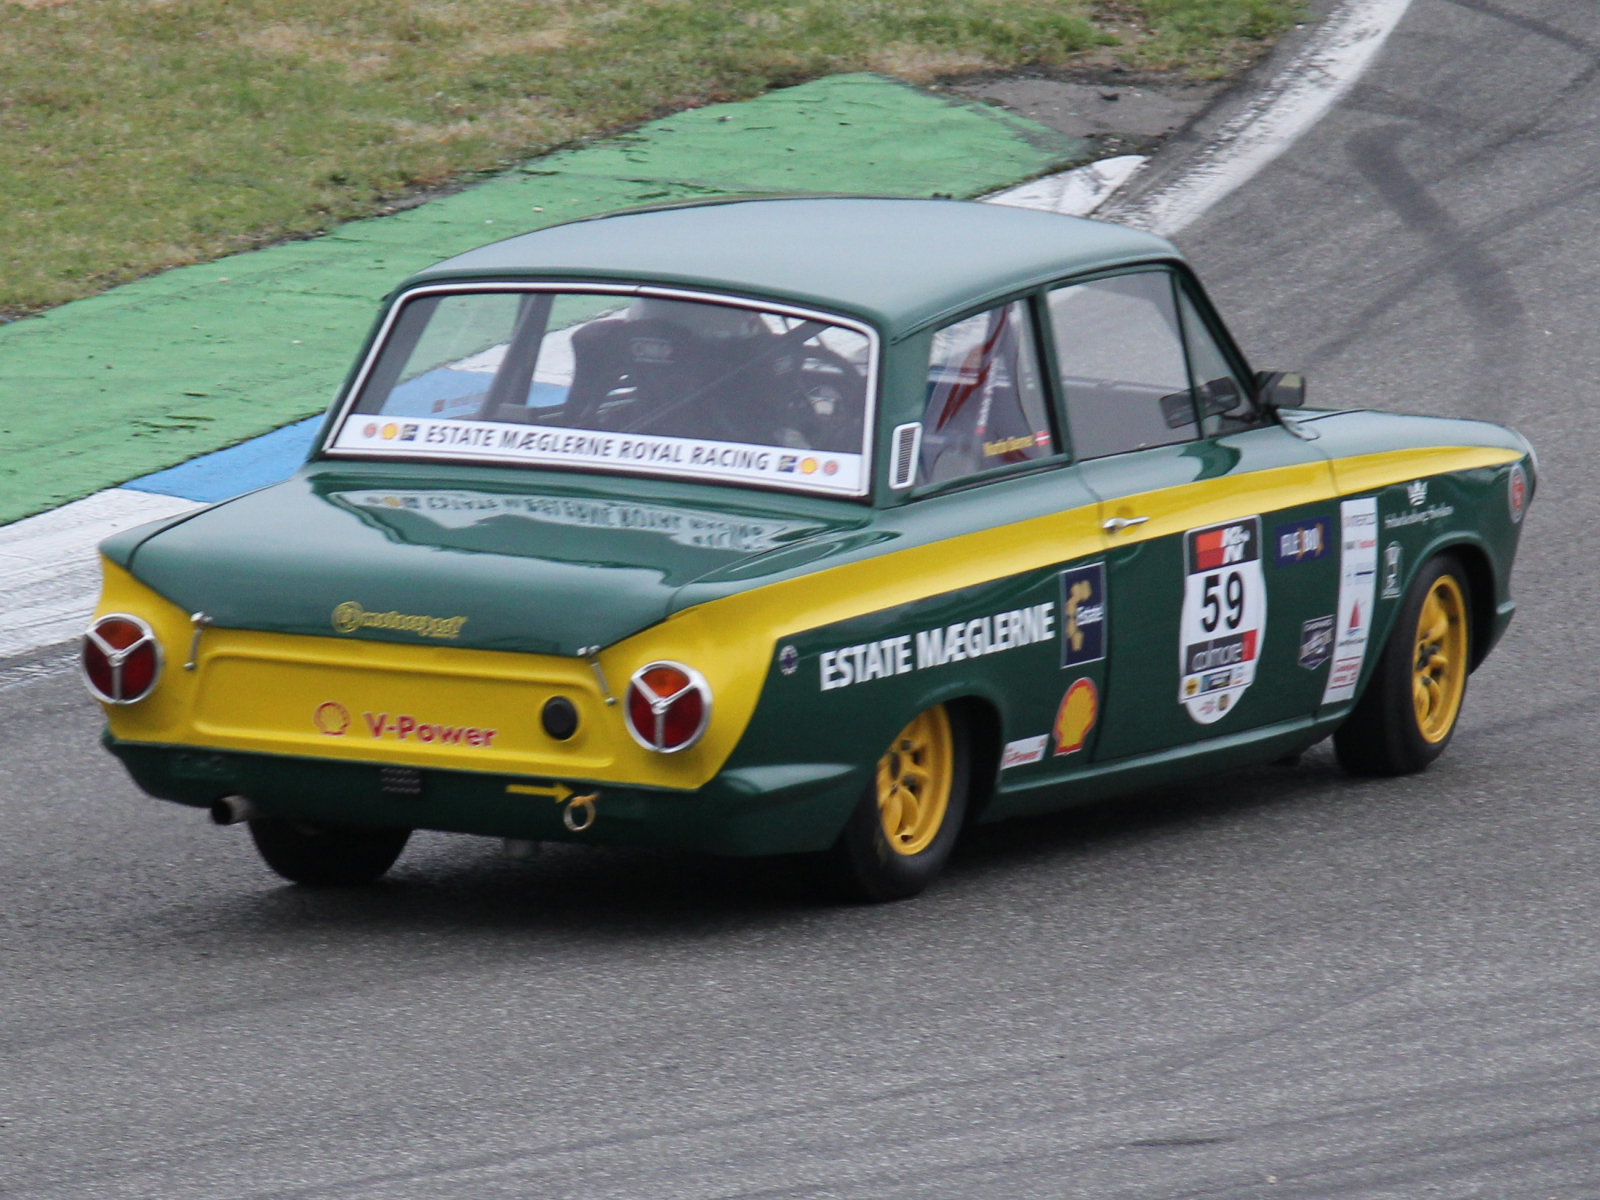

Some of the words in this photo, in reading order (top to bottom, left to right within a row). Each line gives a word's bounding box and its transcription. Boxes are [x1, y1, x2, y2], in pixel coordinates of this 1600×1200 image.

[424, 424, 494, 447] ESTATE
[499, 430, 616, 457] MÆGLERNE
[618, 440, 683, 462] ROYAL
[689, 446, 771, 471] RACING
[1200, 570, 1244, 633] 59
[818, 633, 913, 692] ESTATE
[915, 600, 1056, 671] MÆGLERNE
[362, 711, 498, 747] V-Power
